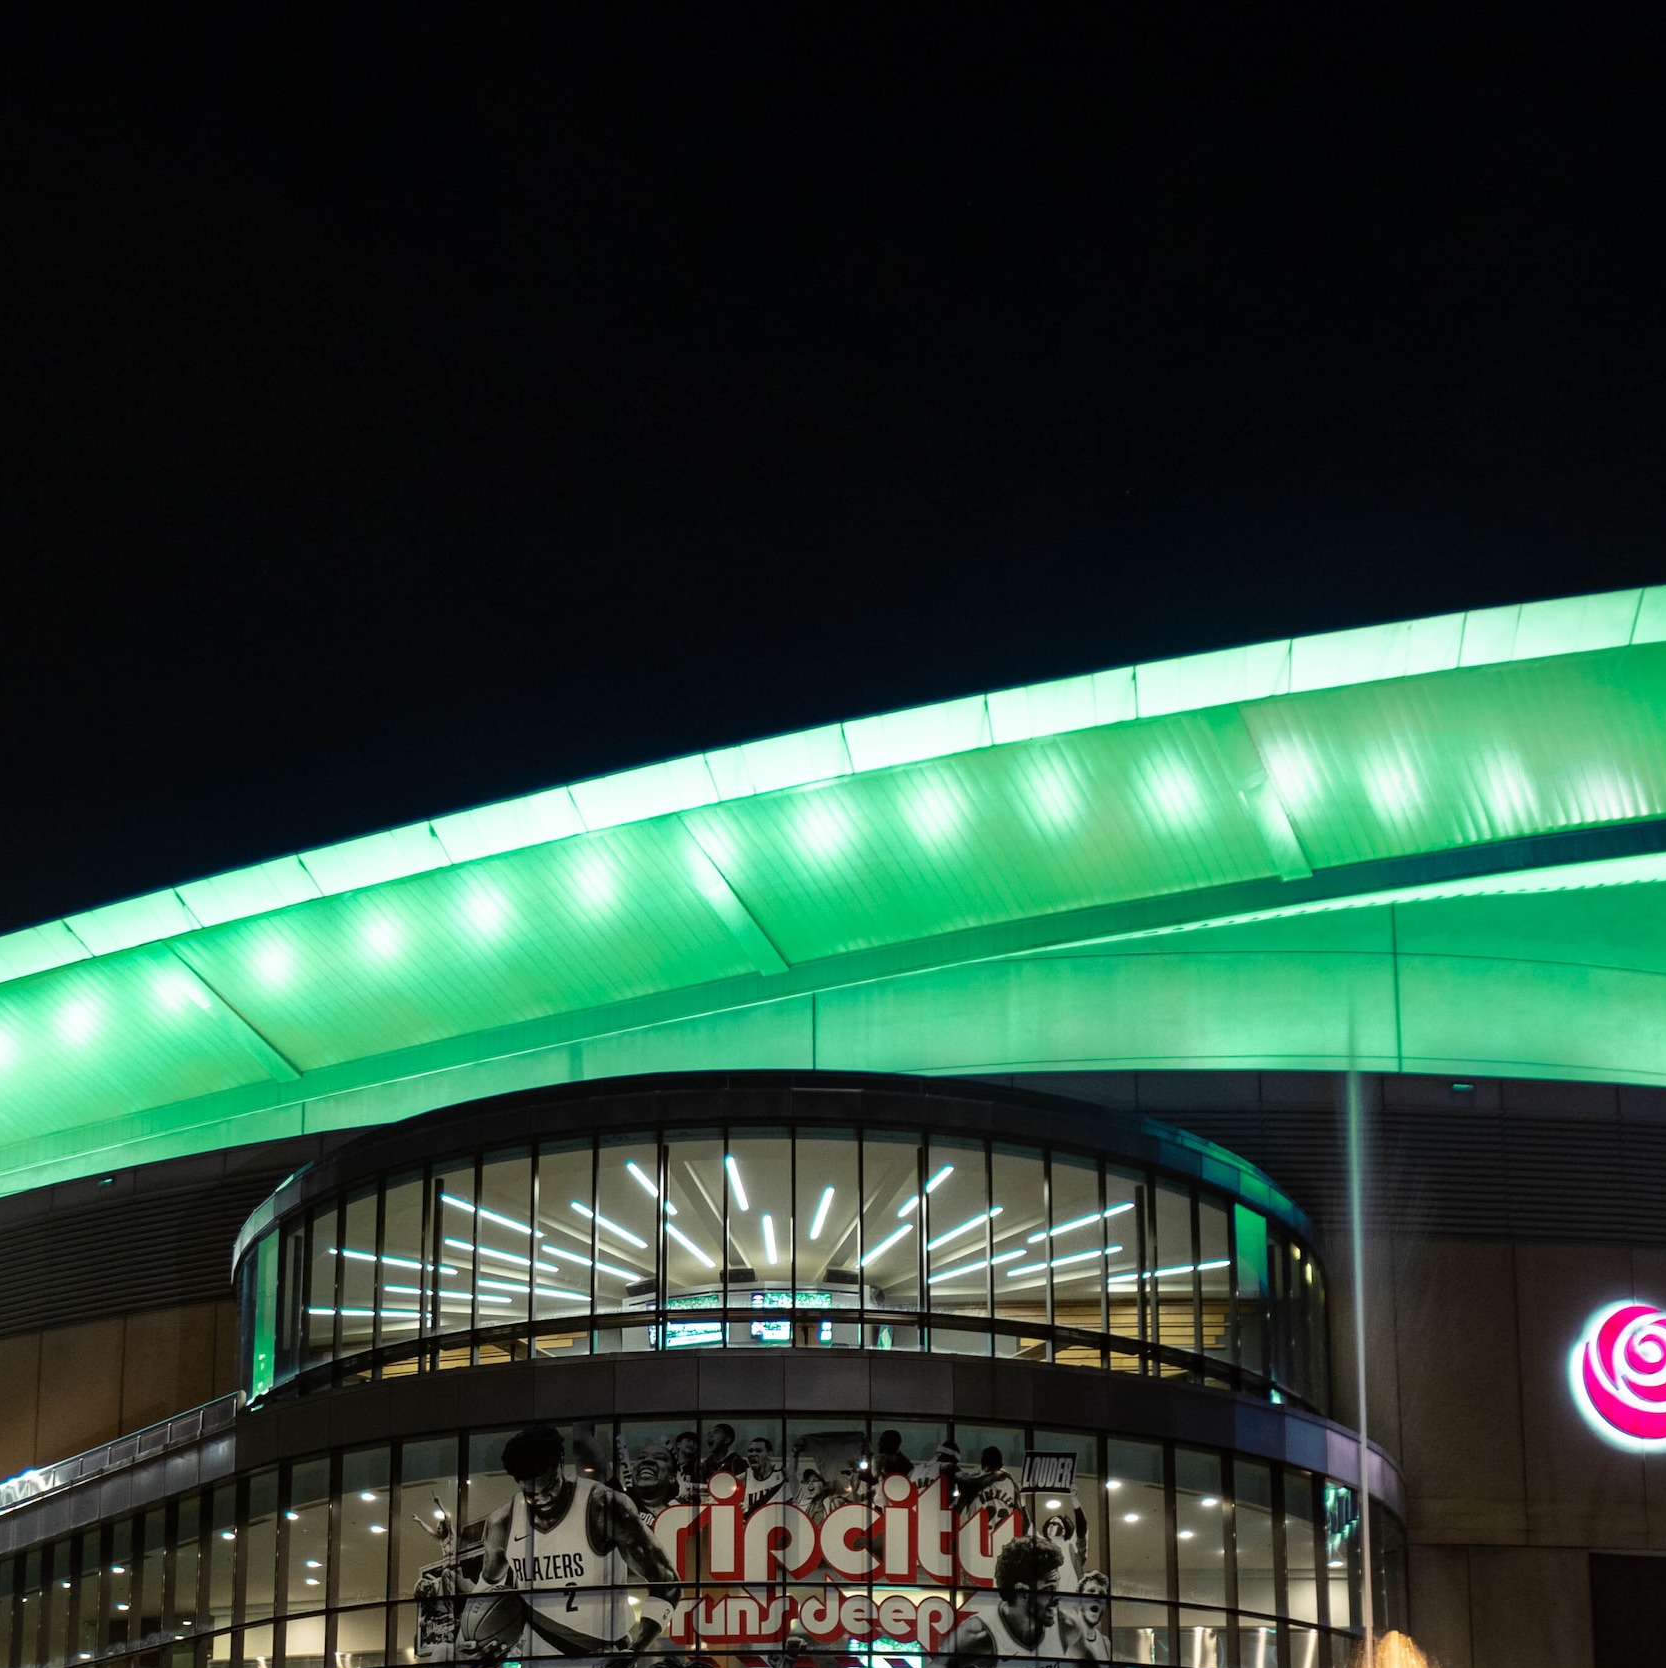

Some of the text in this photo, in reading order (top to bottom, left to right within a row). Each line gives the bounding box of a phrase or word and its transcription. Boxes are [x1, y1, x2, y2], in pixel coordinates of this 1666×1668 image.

[1022, 1456, 1075, 1489] LOUDER
[512, 1551, 585, 1583] BLAZERS
[563, 1582, 579, 1613] 2
[670, 1577, 957, 1654] runs deep
